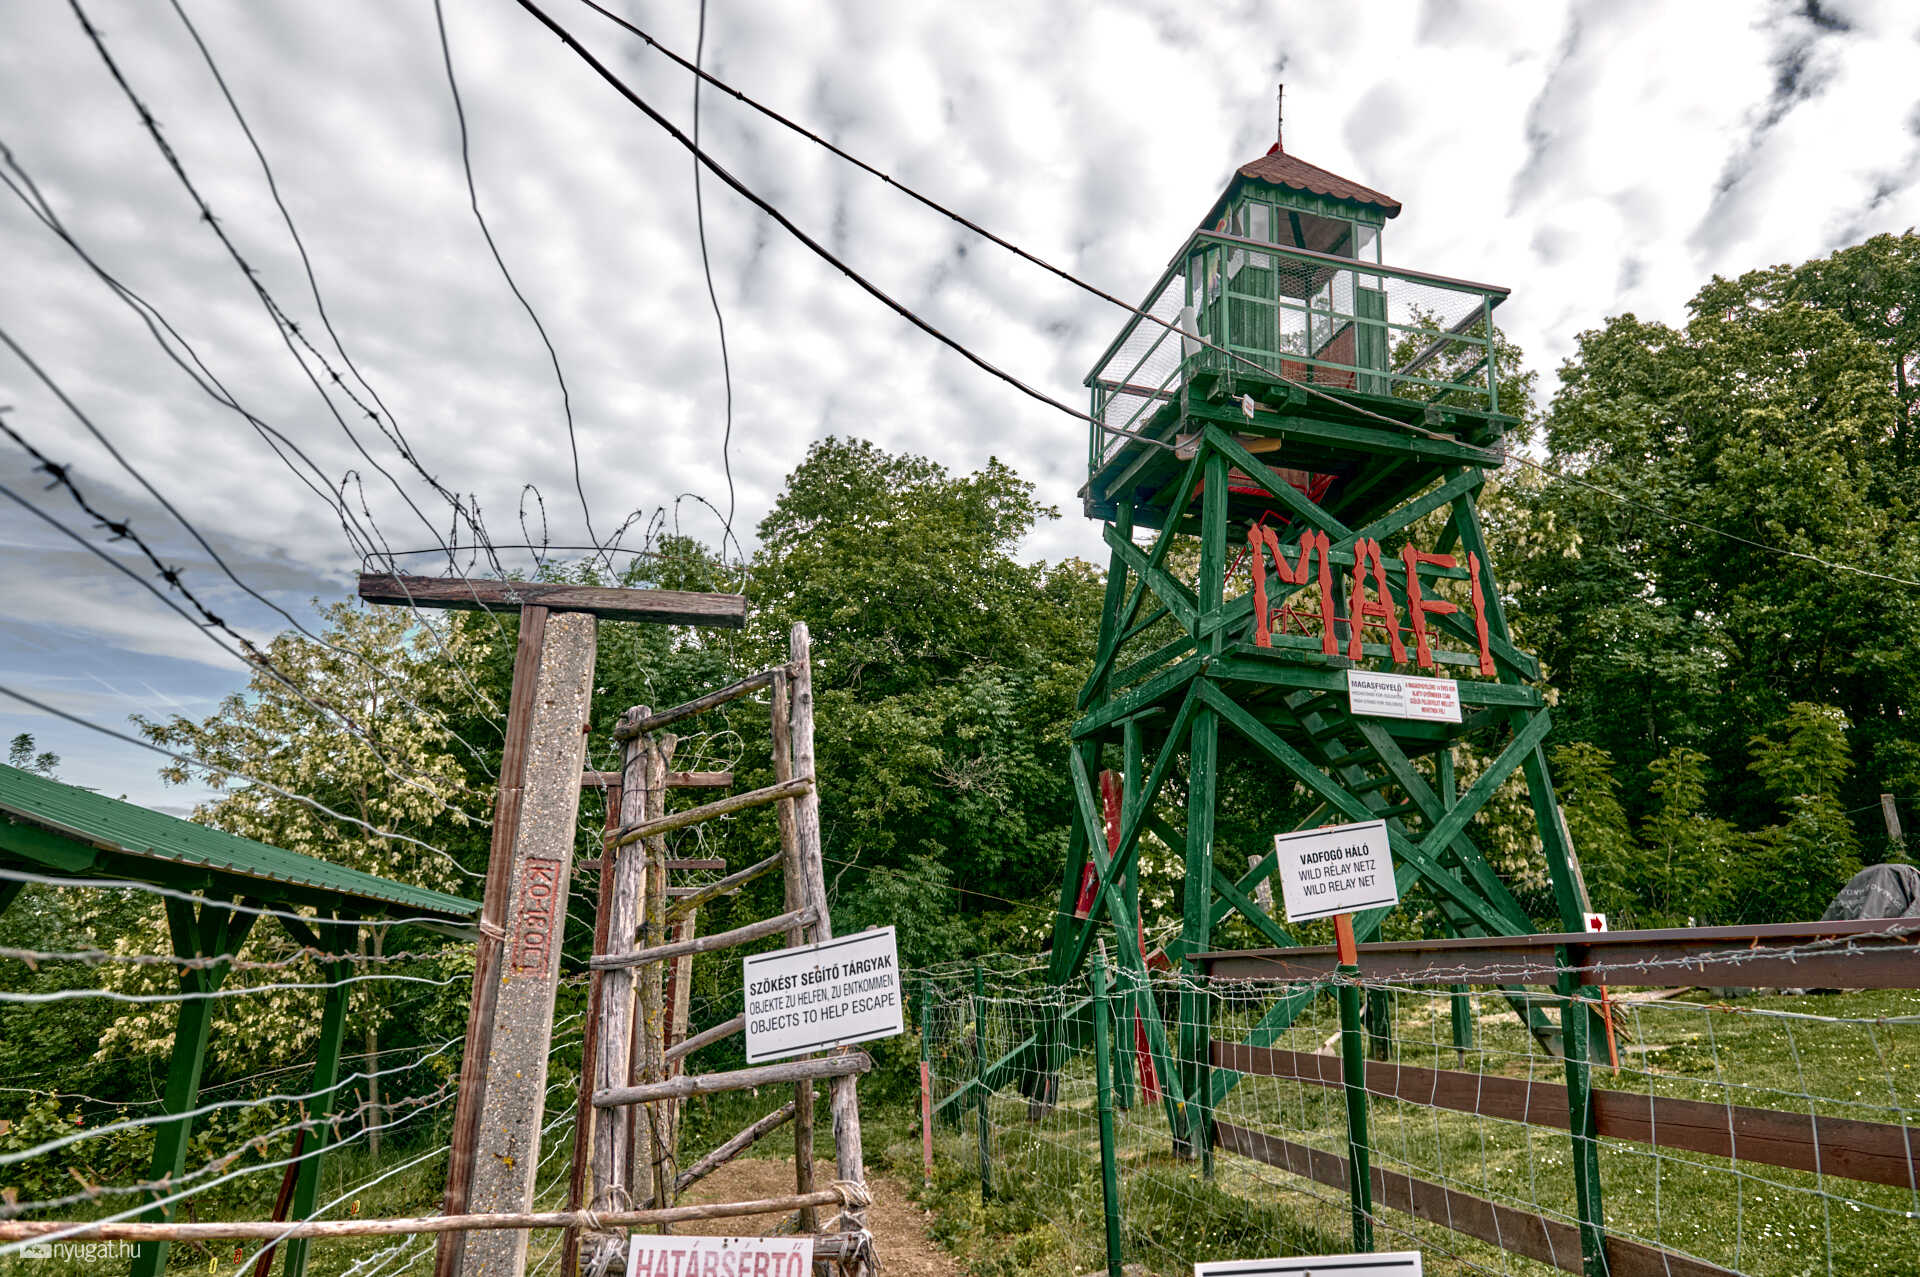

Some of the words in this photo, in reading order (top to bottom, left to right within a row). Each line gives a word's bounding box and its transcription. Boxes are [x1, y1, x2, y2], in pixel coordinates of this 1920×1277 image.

[1298, 868, 1321, 881] WILD
[1324, 863, 1351, 877] RELAY
[1353, 859, 1376, 871] NETZ
[1303, 883, 1326, 896] WILD
[1329, 878, 1356, 892] RELAY
[1358, 875, 1375, 887] NET
[750, 974, 798, 996] SZÖKÉST
[801, 963, 840, 986] SEGÍTŐ
[843, 955, 892, 977] TÁRGYAK
[750, 996, 784, 1016] OBJEKTE
[785, 993, 796, 1009] ZU
[831, 986, 842, 999] ZU
[843, 973, 894, 997] ENTKOMMEN
[750, 1013, 800, 1035] OBJECTS
[802, 1009, 818, 1024] TO
[820, 1002, 849, 1021] HELP
[852, 992, 896, 1014] ESCAPE
